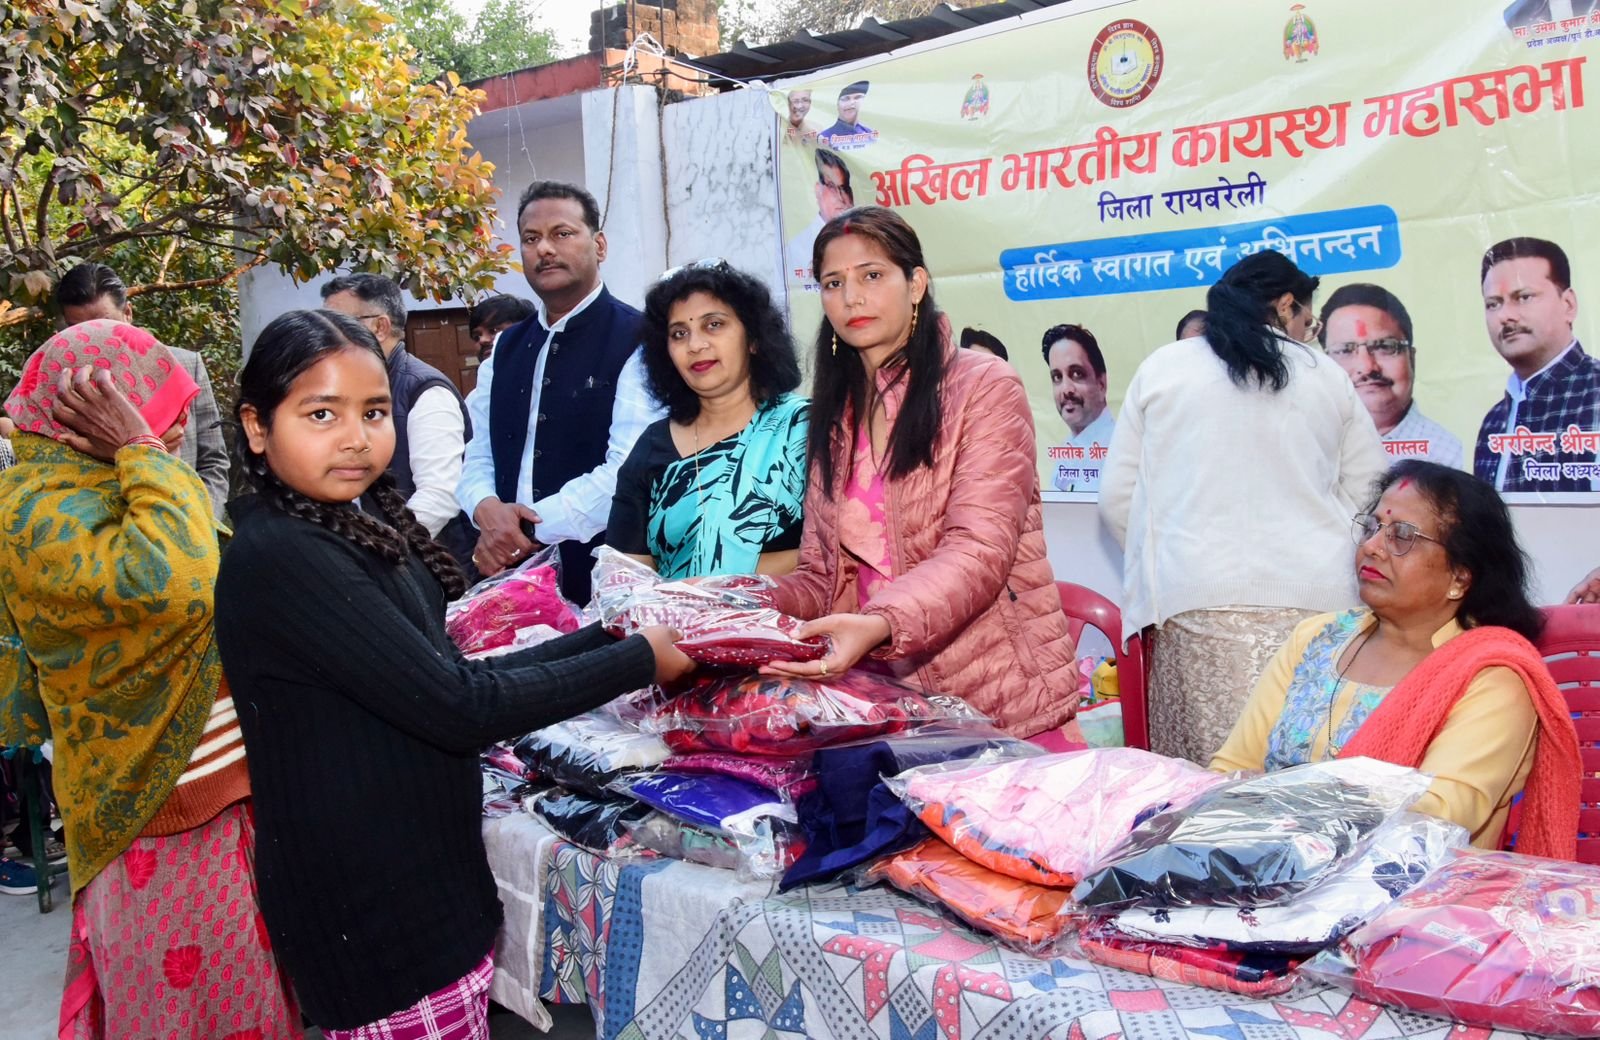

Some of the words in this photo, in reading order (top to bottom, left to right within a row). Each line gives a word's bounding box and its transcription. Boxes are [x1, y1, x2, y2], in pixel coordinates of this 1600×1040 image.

[1533, 22, 1556, 34] उमेश
[1560, 16, 1586, 32] कुमार
[1591, 10, 1600, 24] श्री
[1526, 39, 1544, 48] प्रदेश
[869, 153, 992, 208] अखिल
[1000, 126, 1162, 192] भारतीय
[1172, 100, 1352, 168] कायस्थ
[1363, 56, 1587, 138] महासभा
[1097, 191, 1153, 222] जिला
[1161, 171, 1267, 214] रायबरेली
[1013, 249, 1083, 292] हार्दिक
[1091, 250, 1175, 282] स्वागत
[1184, 236, 1228, 280] एवं
[1382, 440, 1429, 455] वास्तव
[1489, 427, 1555, 453] अरविन्द
[1562, 426, 1600, 453] श्रीव
[1047, 442, 1084, 459] आलोक
[1058, 465, 1080, 478] जिला
[1083, 468, 1099, 482] युवा
[1525, 460, 1559, 479] जिला
